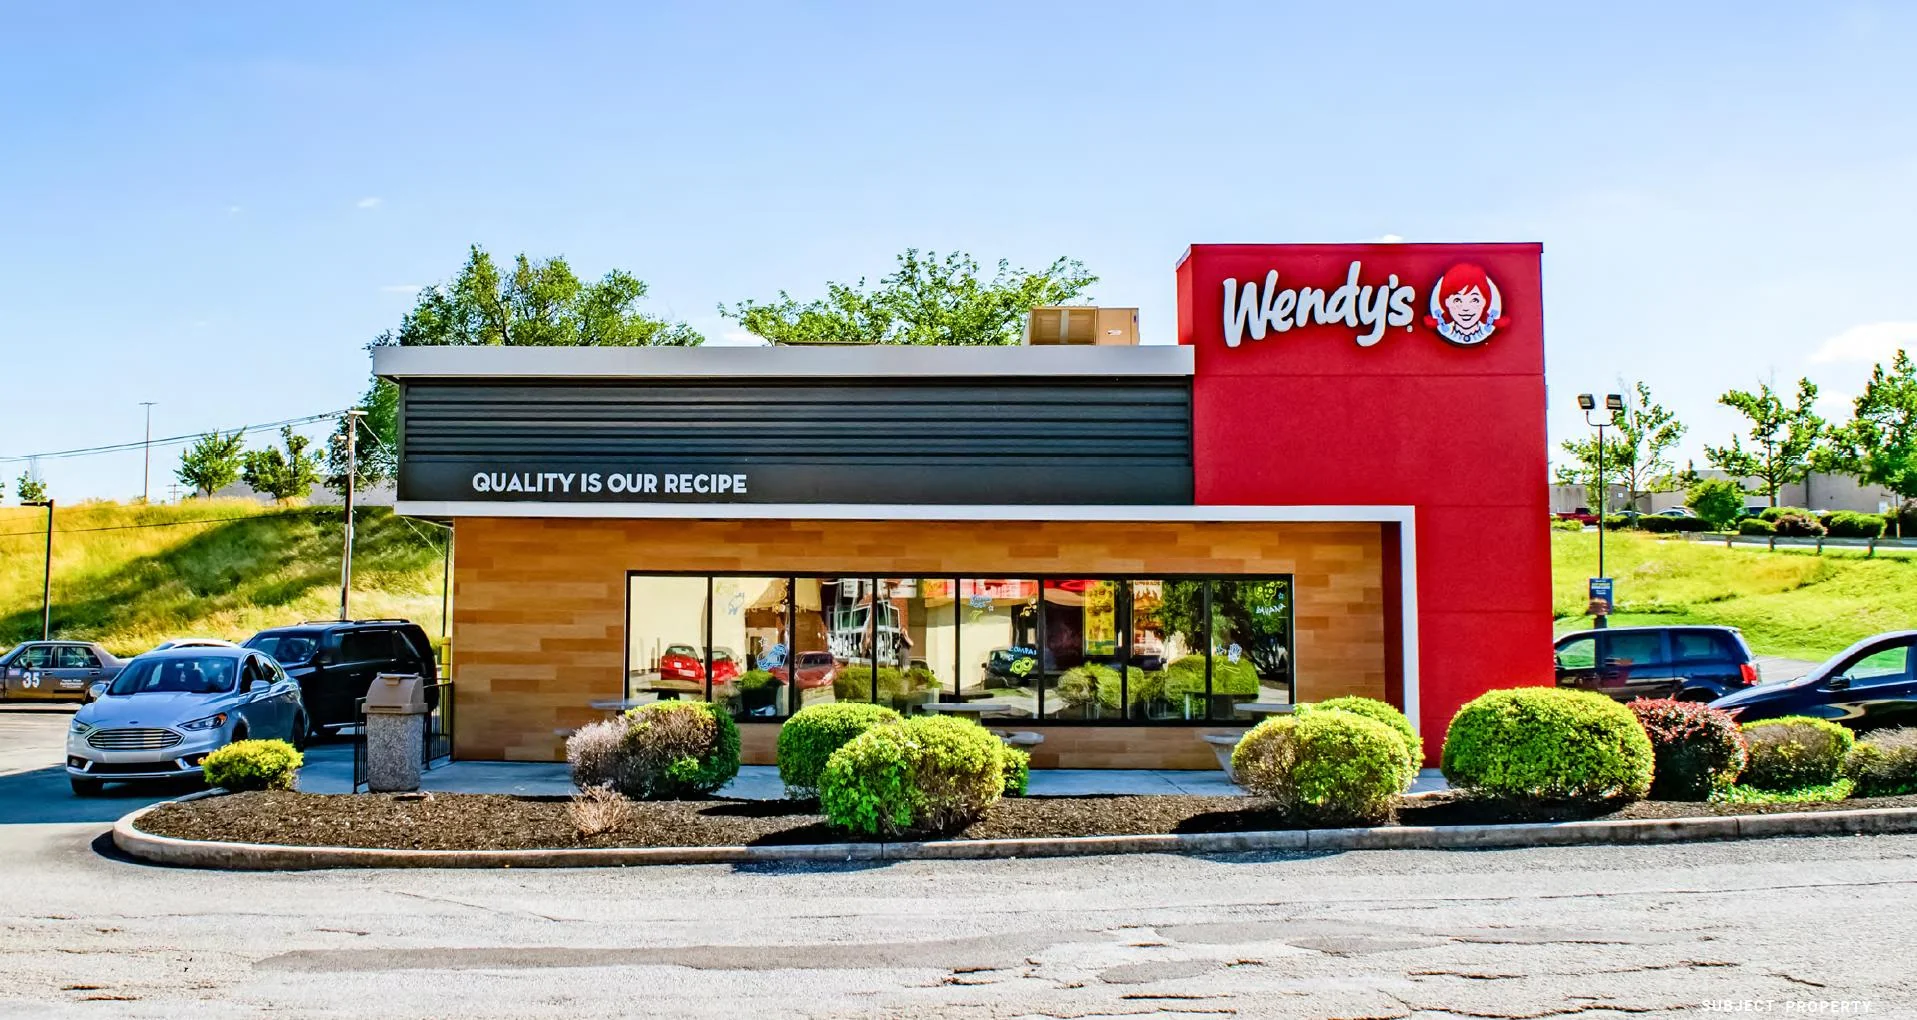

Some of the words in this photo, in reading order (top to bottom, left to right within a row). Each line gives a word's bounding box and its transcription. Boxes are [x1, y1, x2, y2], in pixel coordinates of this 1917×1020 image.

[1223, 260, 1416, 348] Wendy's
[472, 472, 575, 493] QUALITY
[580, 473, 602, 493] IS
[607, 473, 658, 493] OUR
[664, 474, 748, 494] RECIPE
[23, 672, 40, 688] 35
